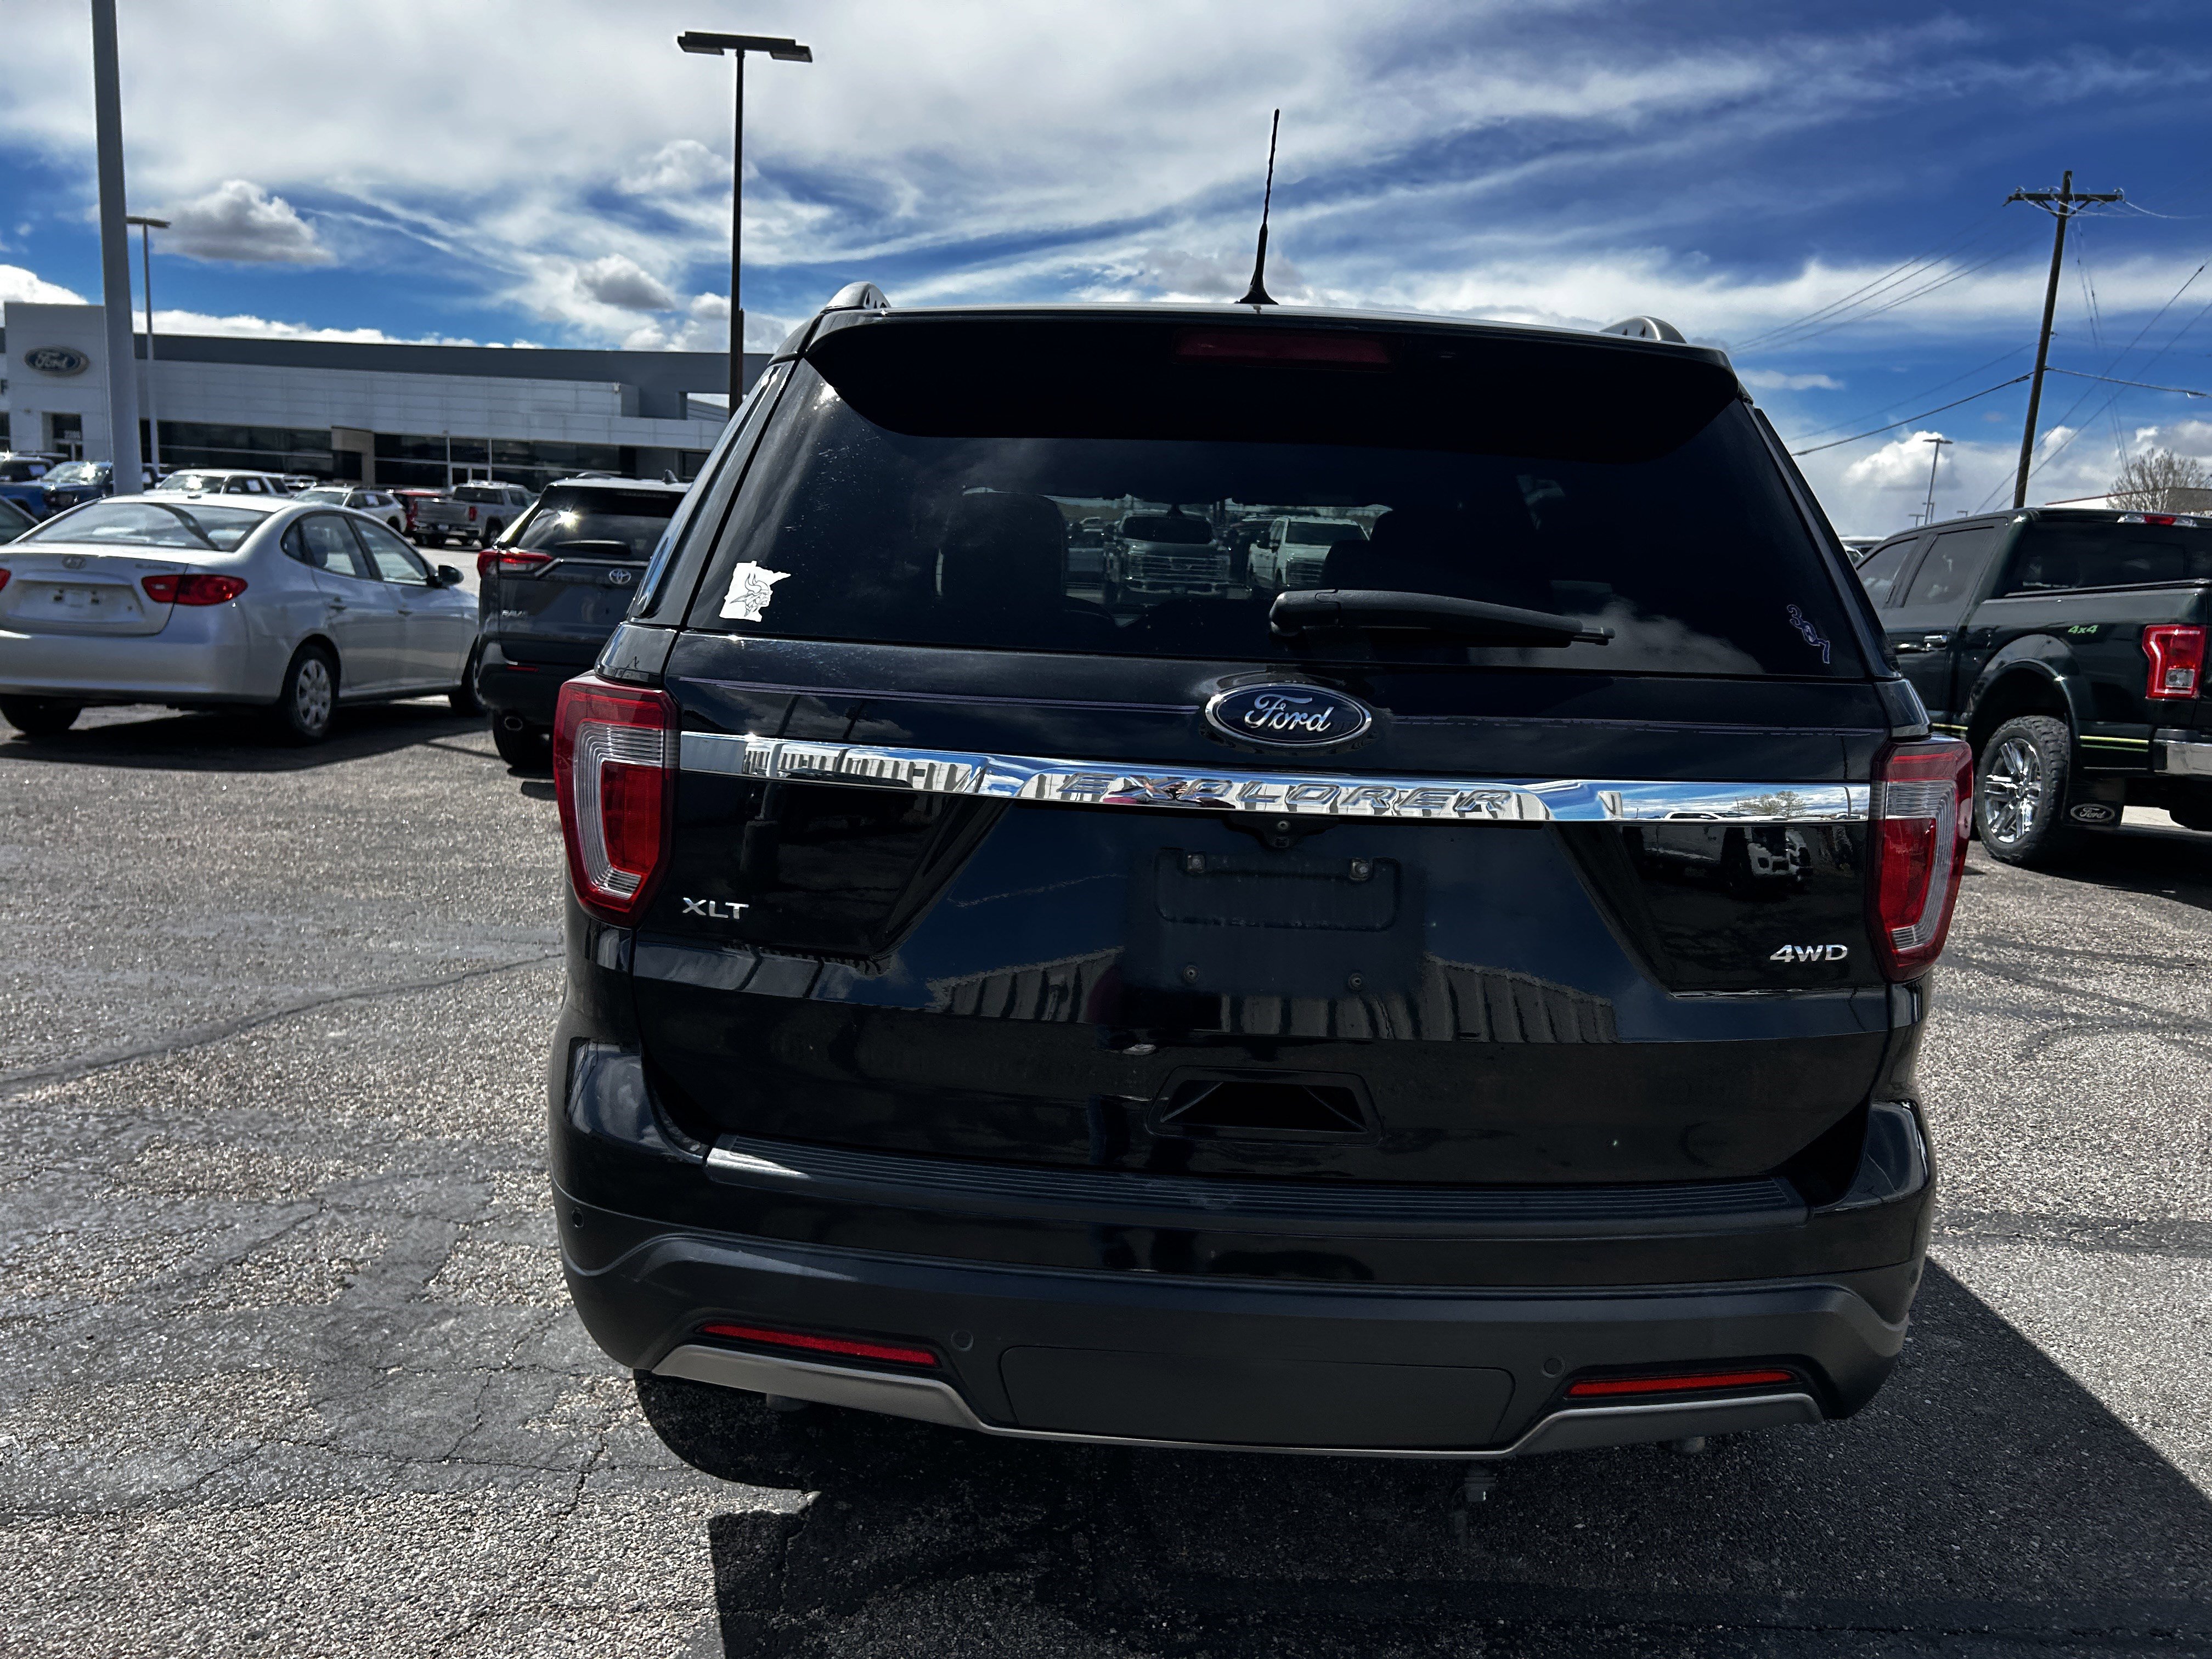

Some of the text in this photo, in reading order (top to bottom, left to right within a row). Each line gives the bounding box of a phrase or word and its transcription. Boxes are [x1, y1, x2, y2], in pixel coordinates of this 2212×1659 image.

[35, 352, 67, 369] Ford
[2068, 625, 2098, 634] 4x4
[1244, 693, 1334, 732] Ford
[1057, 772, 1512, 812] EXPLORER
[2080, 807, 2107, 819] Ford
[682, 897, 749, 919] XLT
[1770, 944, 1848, 962] 4WD
